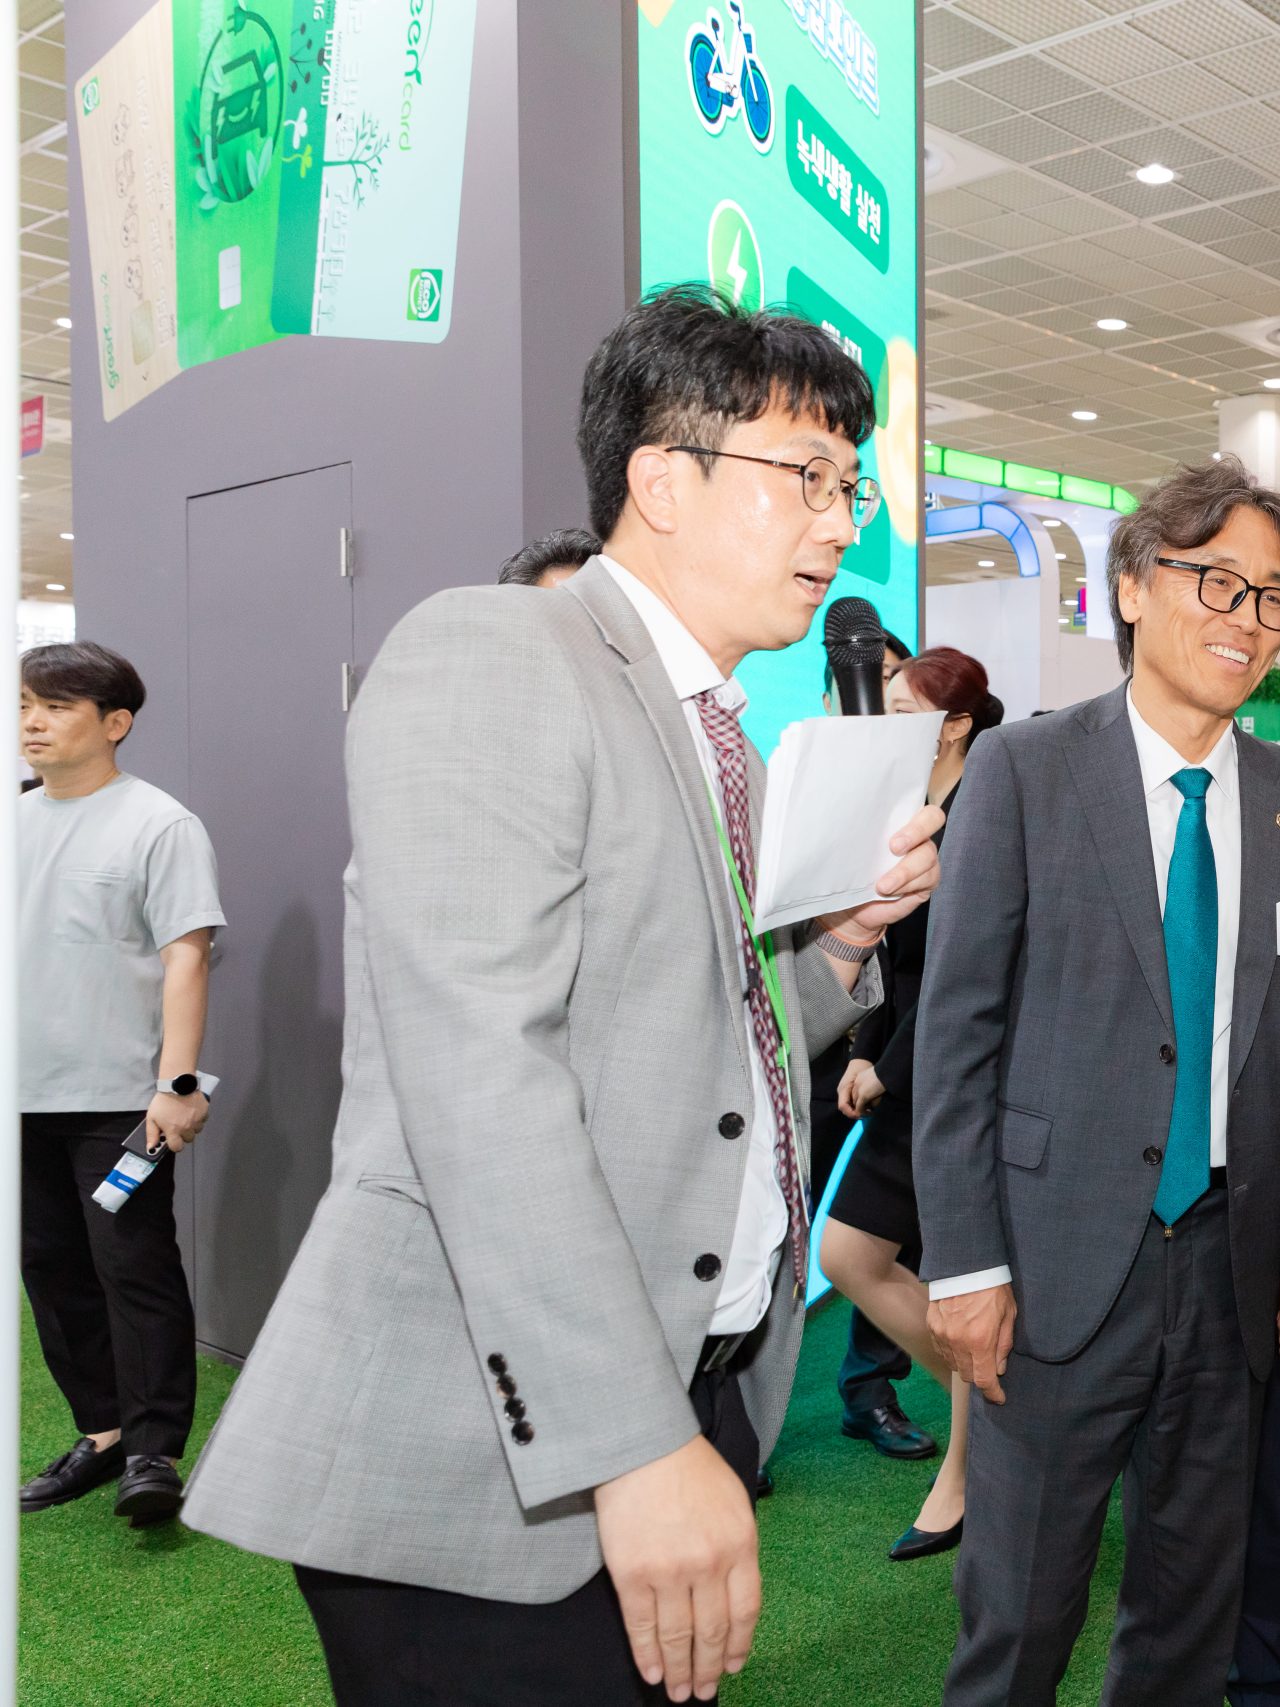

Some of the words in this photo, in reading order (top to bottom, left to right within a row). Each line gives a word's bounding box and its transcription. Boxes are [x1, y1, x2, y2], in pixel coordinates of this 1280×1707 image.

[796, 118, 853, 217] 녹색생활
[855, 183, 881, 245] 실천
[421, 279, 431, 312] ECO
